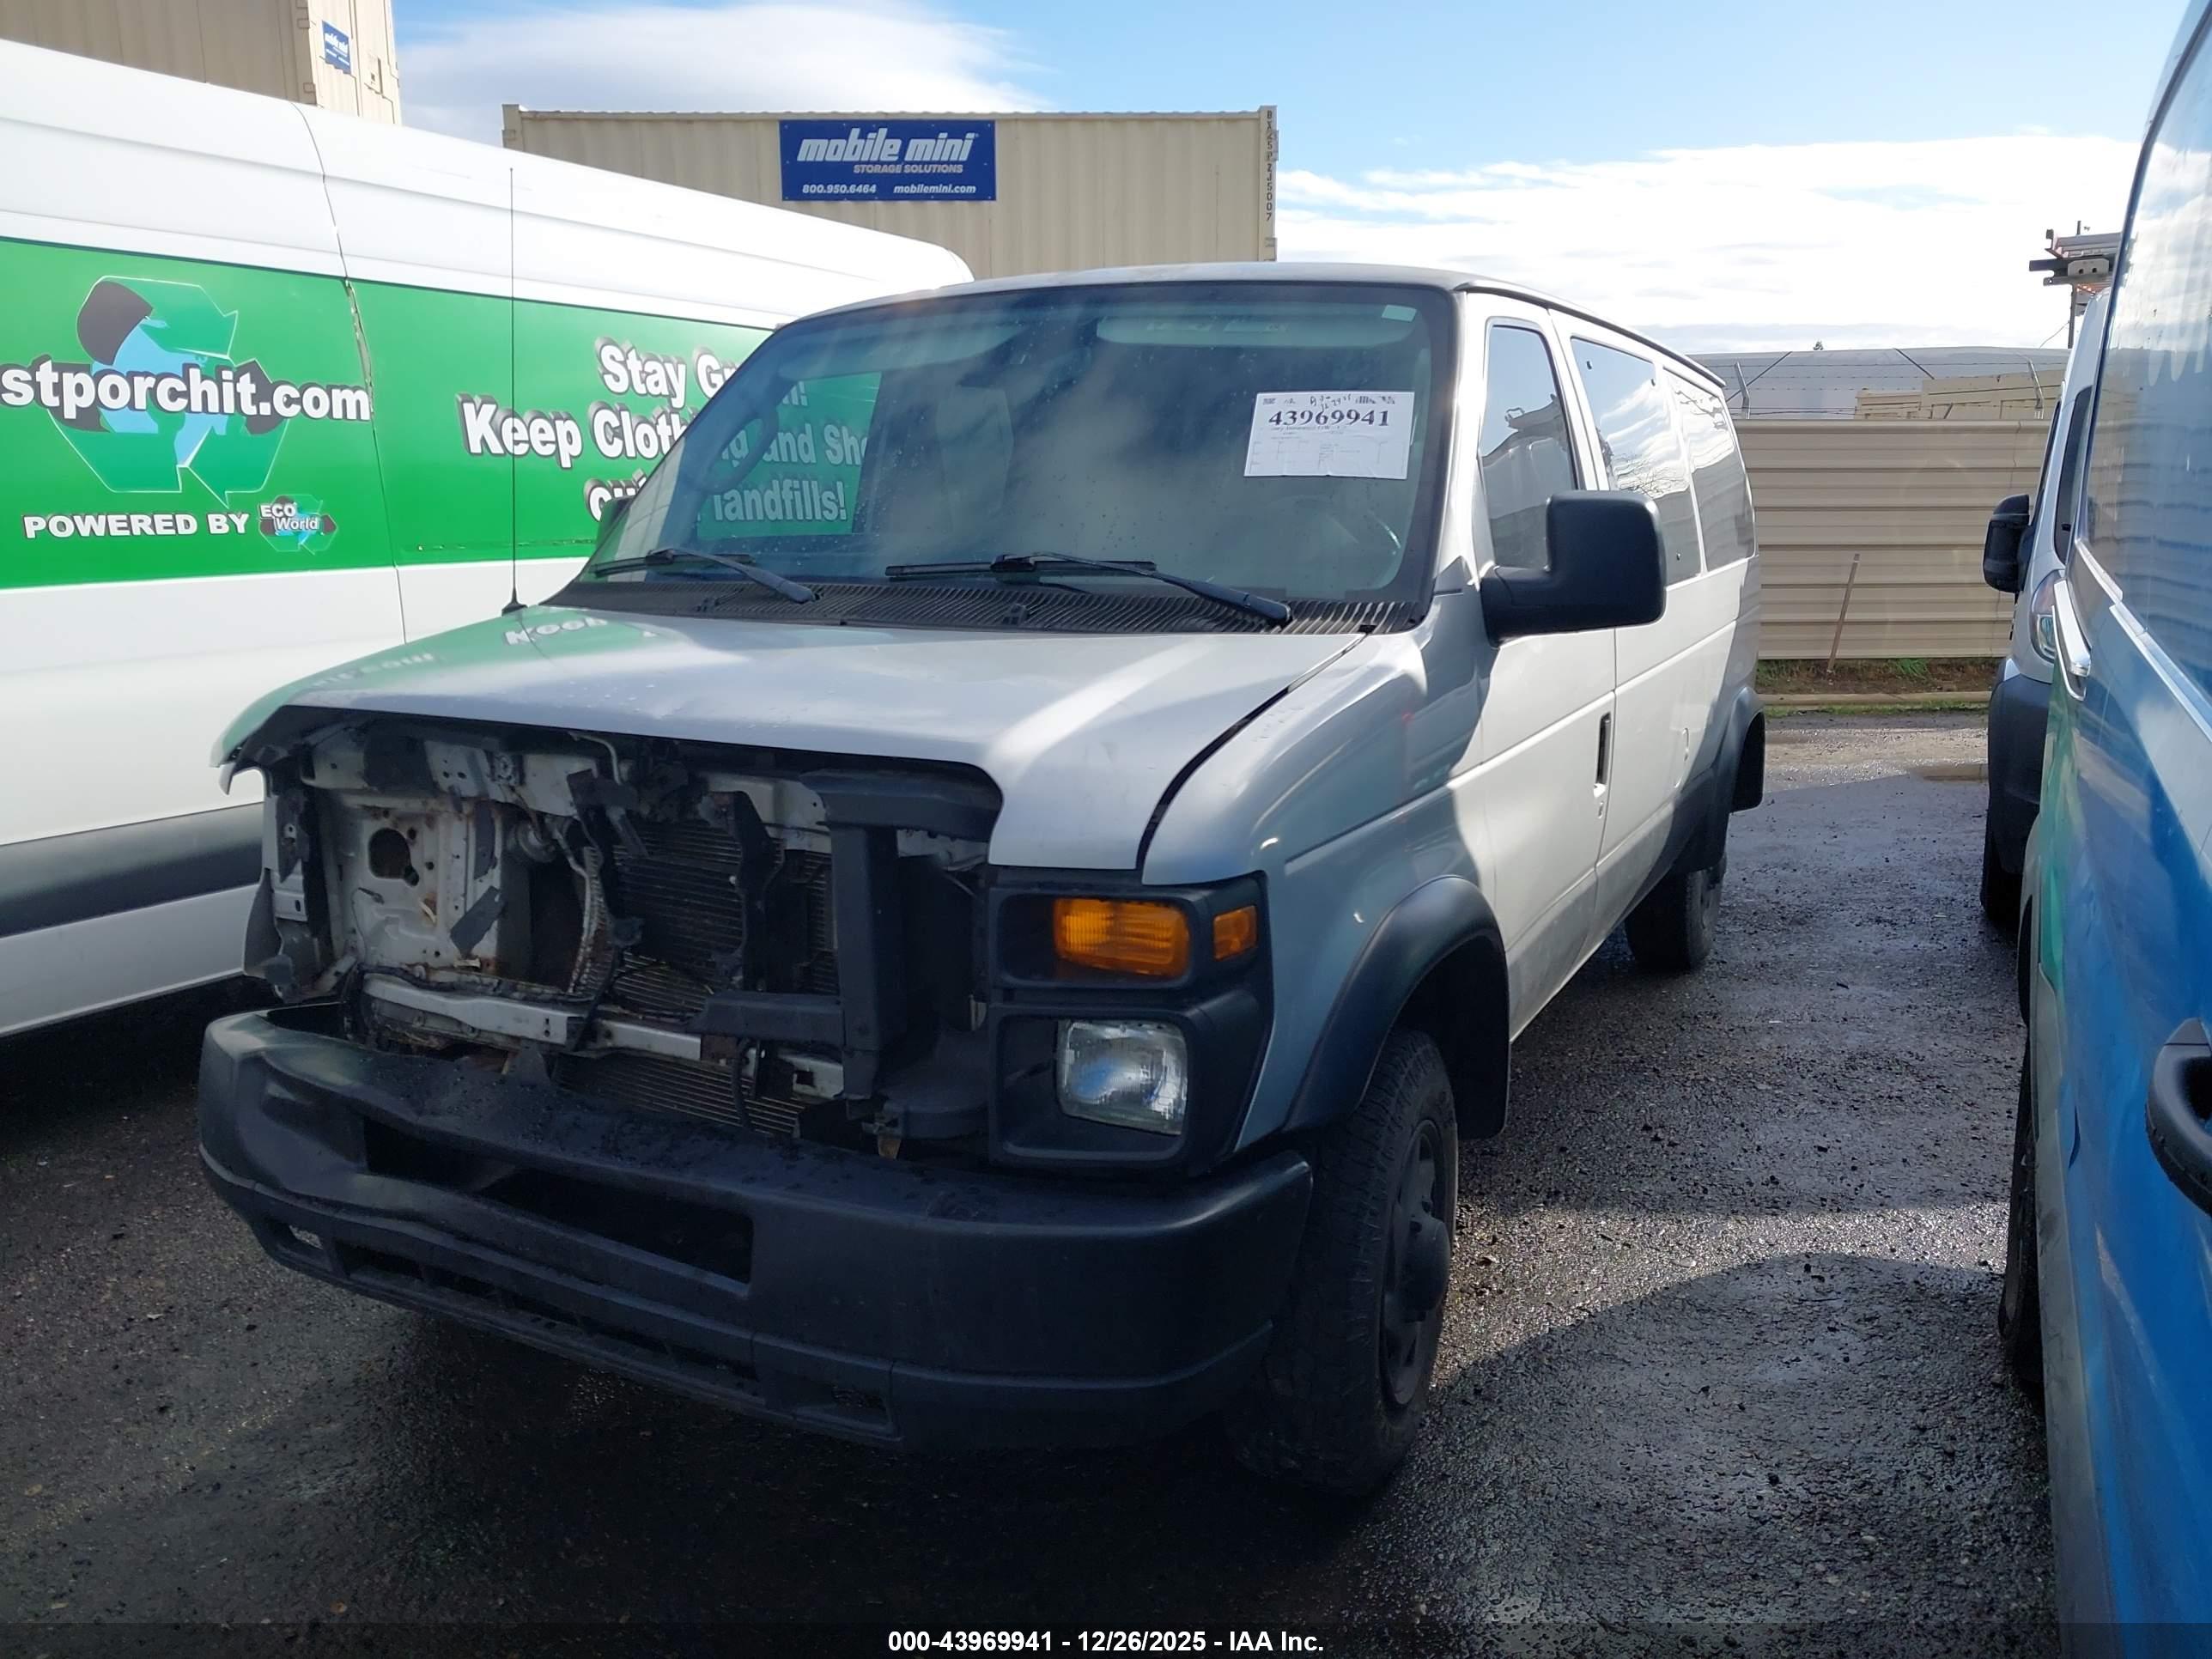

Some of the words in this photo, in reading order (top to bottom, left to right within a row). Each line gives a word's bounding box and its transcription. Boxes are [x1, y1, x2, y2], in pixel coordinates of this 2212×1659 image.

[797, 128, 902, 161] mobile
[854, 164, 902, 173] STORAGE
[904, 164, 963, 173] SOLUTIONS
[802, 184, 877, 194] 800.950.6464
[893, 184, 976, 194] mobilemini.com
[597, 340, 686, 408] Stay
[0, 359, 371, 421] stporchit.com
[1268, 410, 1389, 427] 43969941
[458, 395, 583, 468] Keep
[260, 504, 296, 518] ECO
[24, 514, 198, 539] POWERED
[208, 514, 250, 534] BY
[275, 517, 319, 530] World
